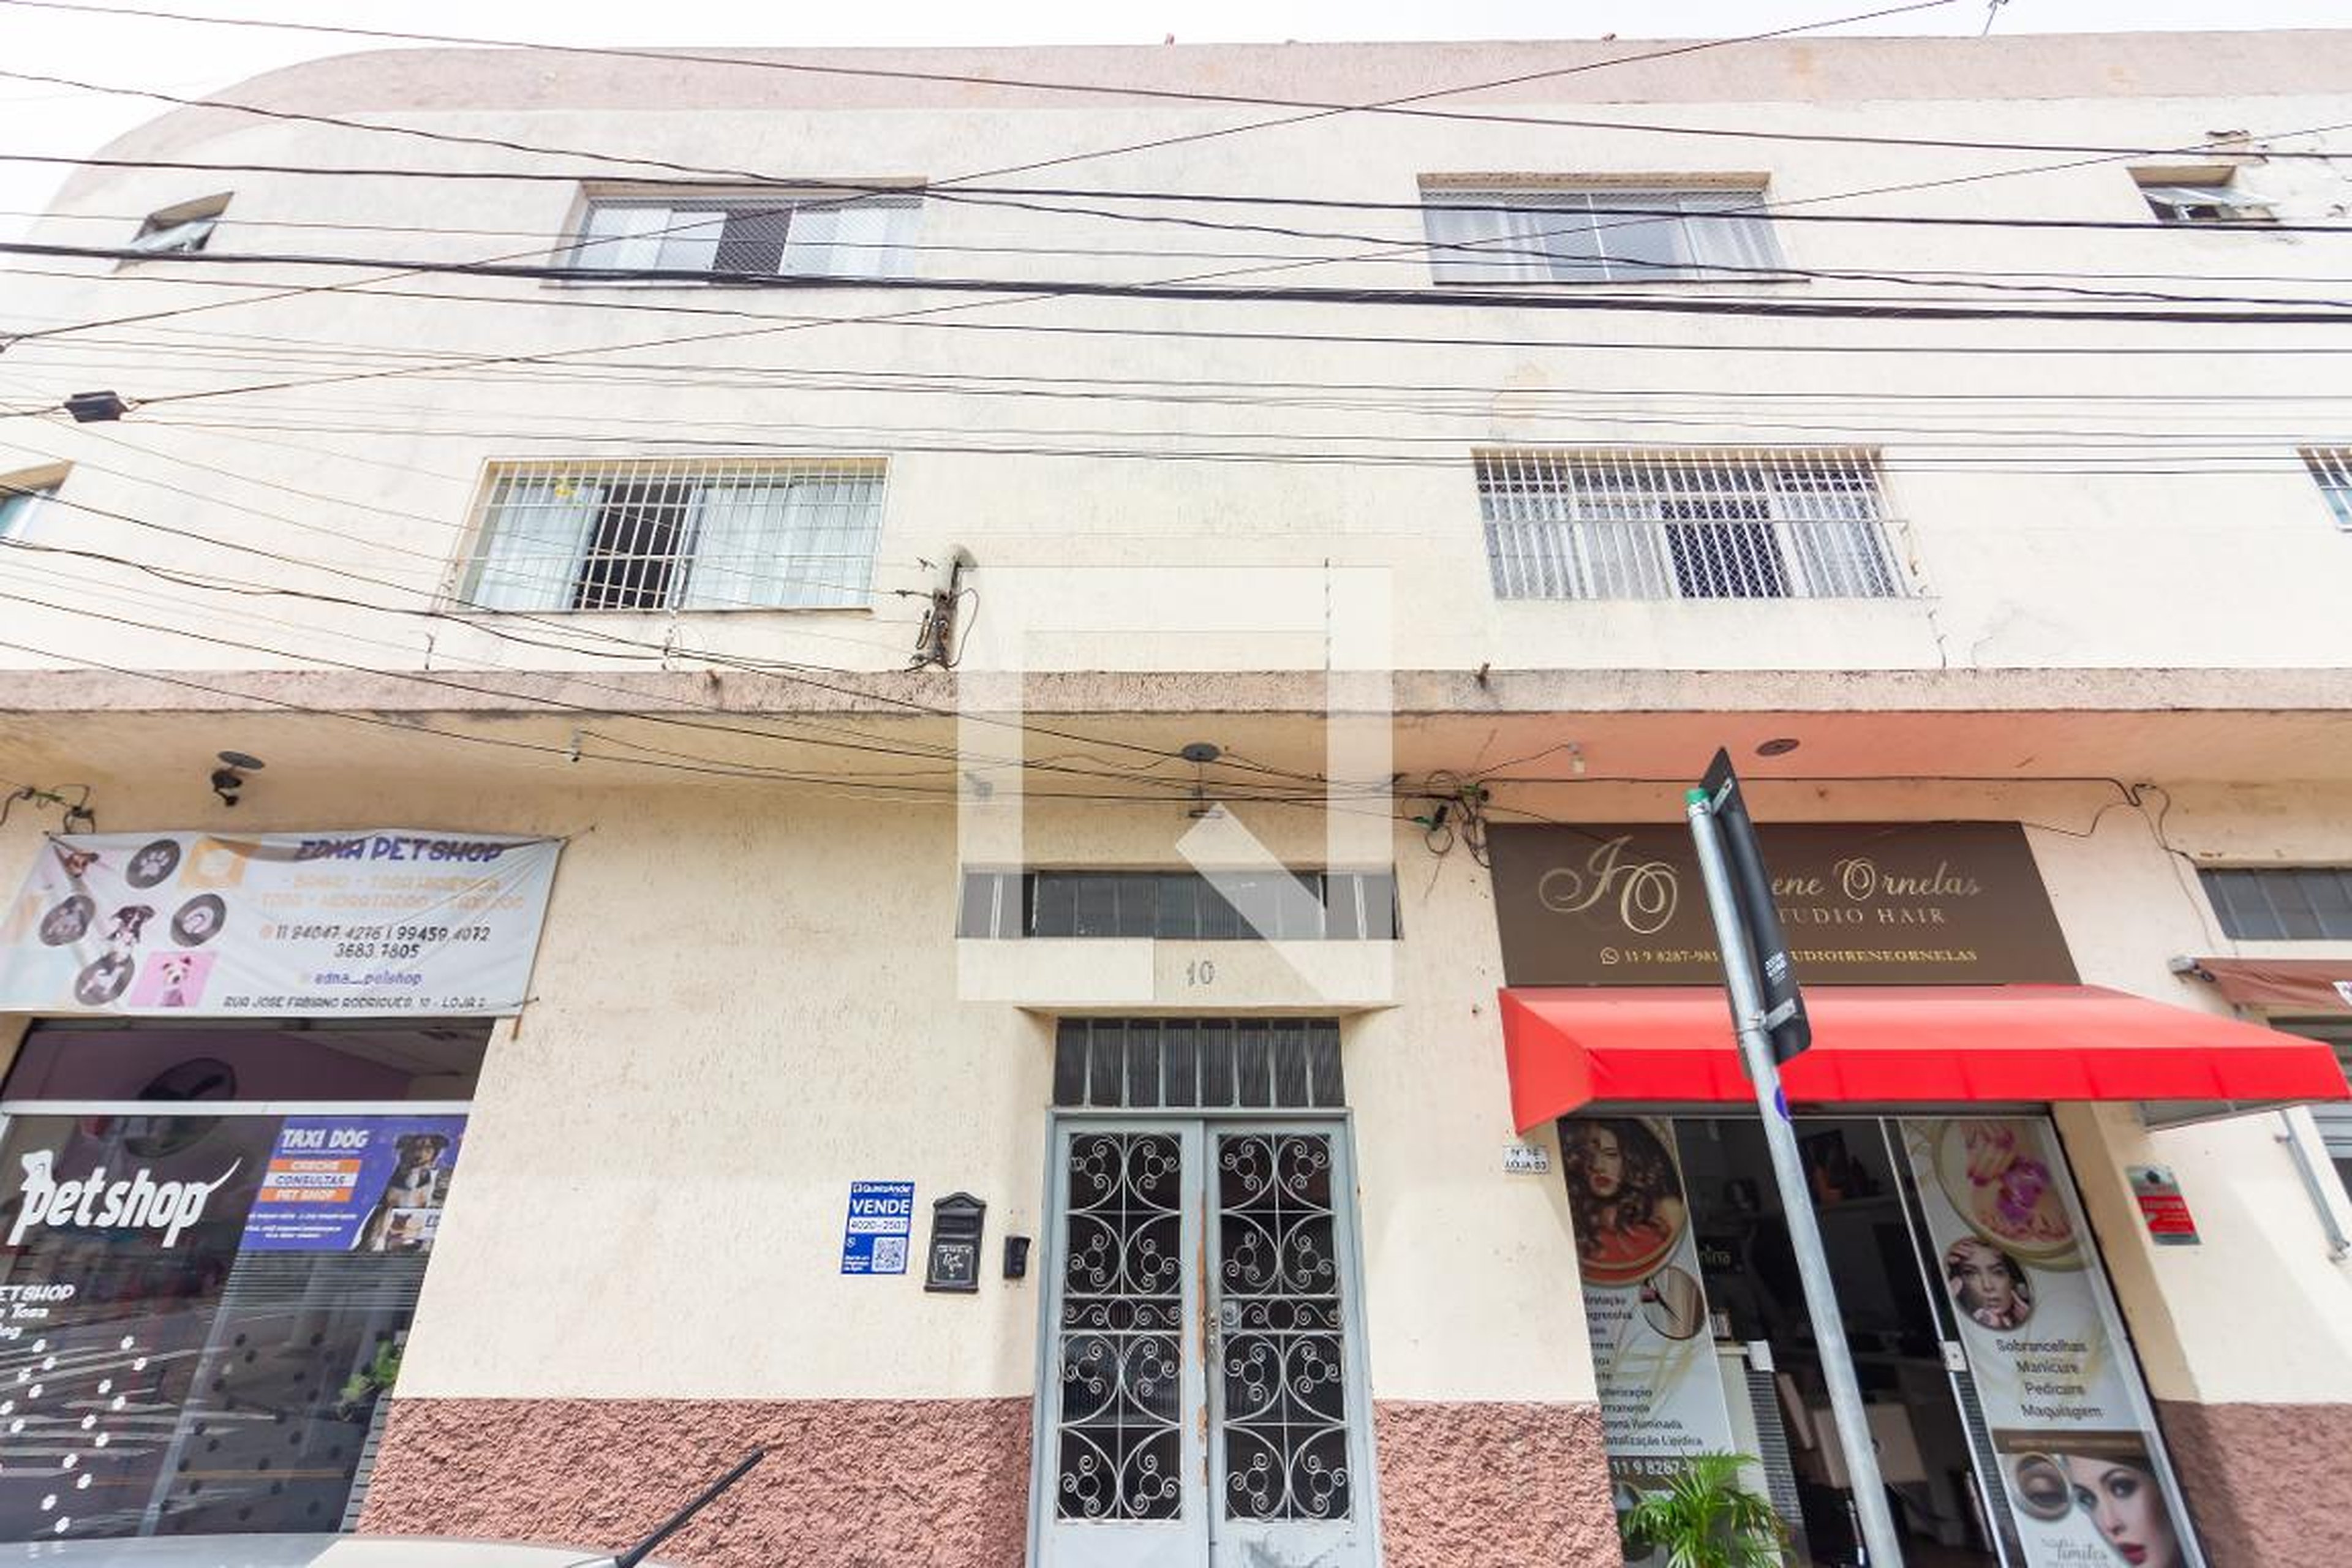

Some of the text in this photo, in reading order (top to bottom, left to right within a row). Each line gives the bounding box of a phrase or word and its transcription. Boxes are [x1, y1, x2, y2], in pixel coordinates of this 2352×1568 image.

[295, 840, 366, 860] EDNA
[1771, 880, 1826, 895] ene
[1779, 908, 1945, 924] TUDIO HAIR
[1790, 950, 1978, 962] UDIOIRENEORNELAS
[282, 1128, 369, 1148] TAXI DOG
[6, 1150, 242, 1248] petshop
[852, 1199, 911, 1215] VENDE
[0, 1284, 75, 1302] ETSHOP
[1996, 1338, 2087, 1352] Sobrancelhas
[2016, 1360, 2079, 1373] Manicure
[2024, 1381, 2086, 1395] Pedicure
[2021, 1404, 2103, 1421] Maquiagem
